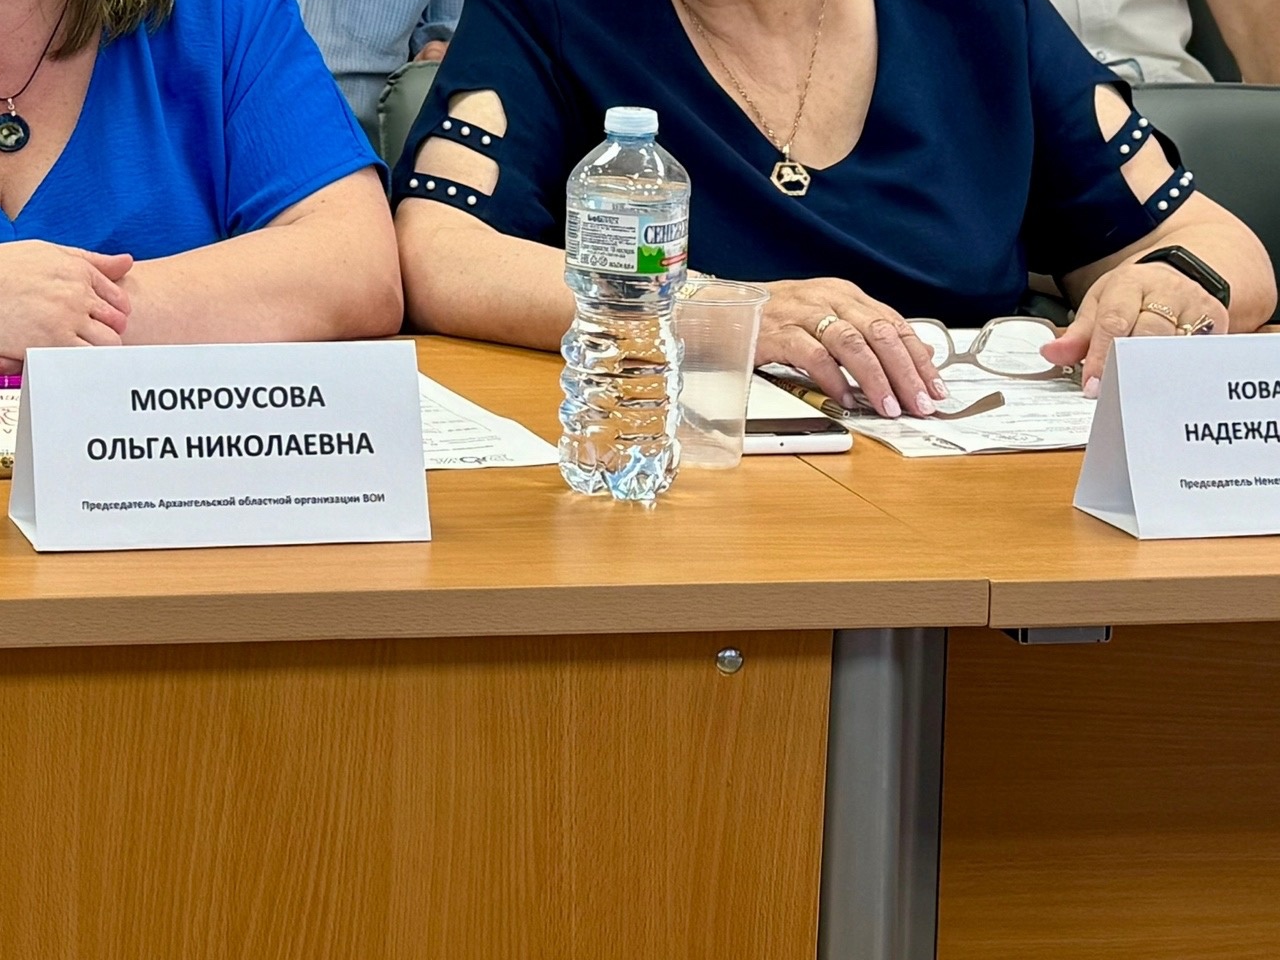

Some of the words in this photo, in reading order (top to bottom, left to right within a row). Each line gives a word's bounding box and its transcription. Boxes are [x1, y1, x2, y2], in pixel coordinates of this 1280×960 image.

[130, 385, 326, 412] МОКРОУСОВА
[1227, 380, 1280, 401] КОВА
[87, 437, 179, 461] ОЛЬГА
[185, 432, 375, 459] НИКОЛАЕВНА
[1179, 477, 1253, 491] Председатель
[81, 498, 156, 512] Председатель
[157, 496, 236, 511] Архангельской
[238, 494, 292, 507] областной
[294, 494, 361, 509] организации
[362, 493, 385, 504] ВОИ
